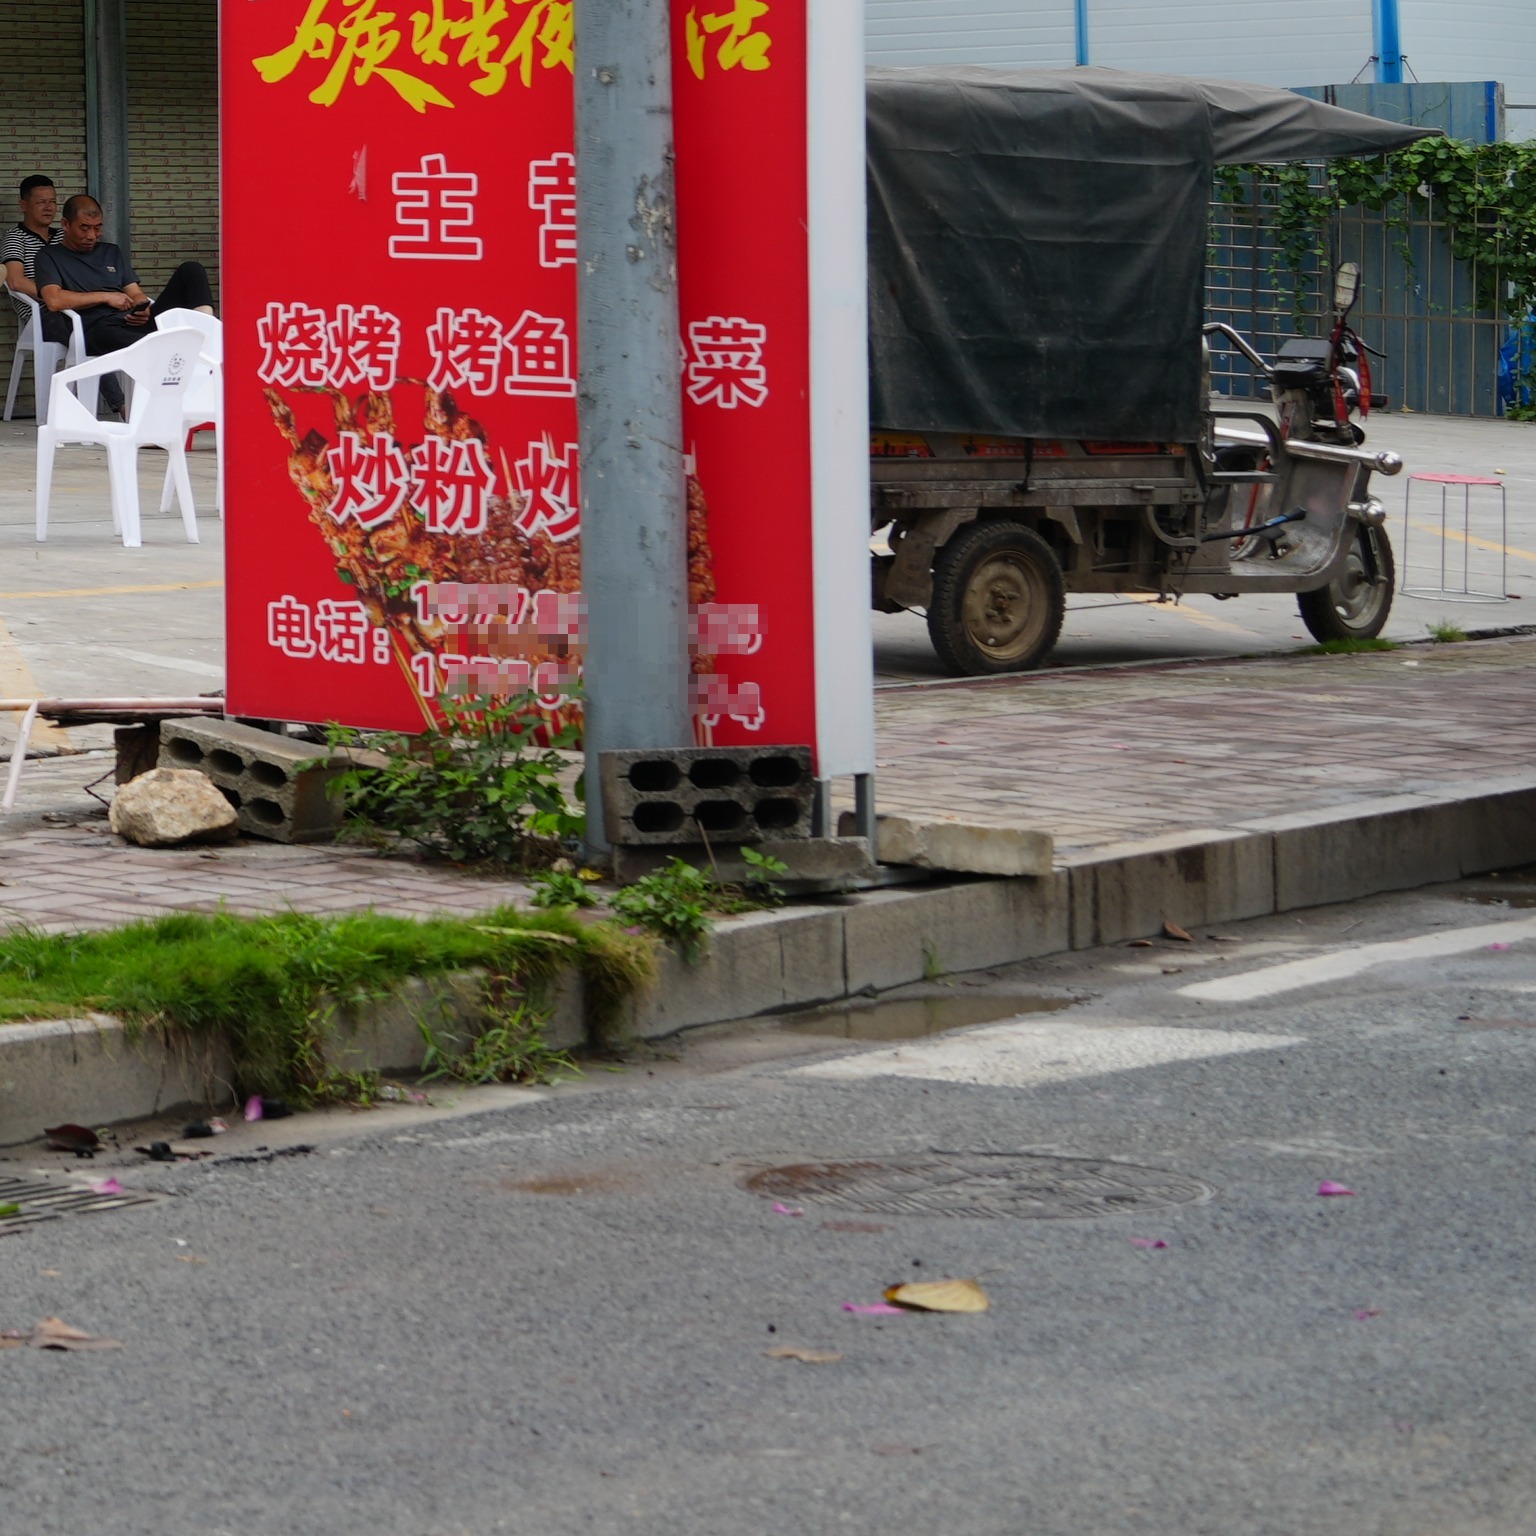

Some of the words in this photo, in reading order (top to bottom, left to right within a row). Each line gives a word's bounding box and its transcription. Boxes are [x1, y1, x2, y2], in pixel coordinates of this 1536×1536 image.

[257, 301, 400, 391] 烧烤
[426, 308, 578, 396] 烤鱼
[678, 316, 769, 408] 菜
[327, 431, 496, 535] 炒粉
